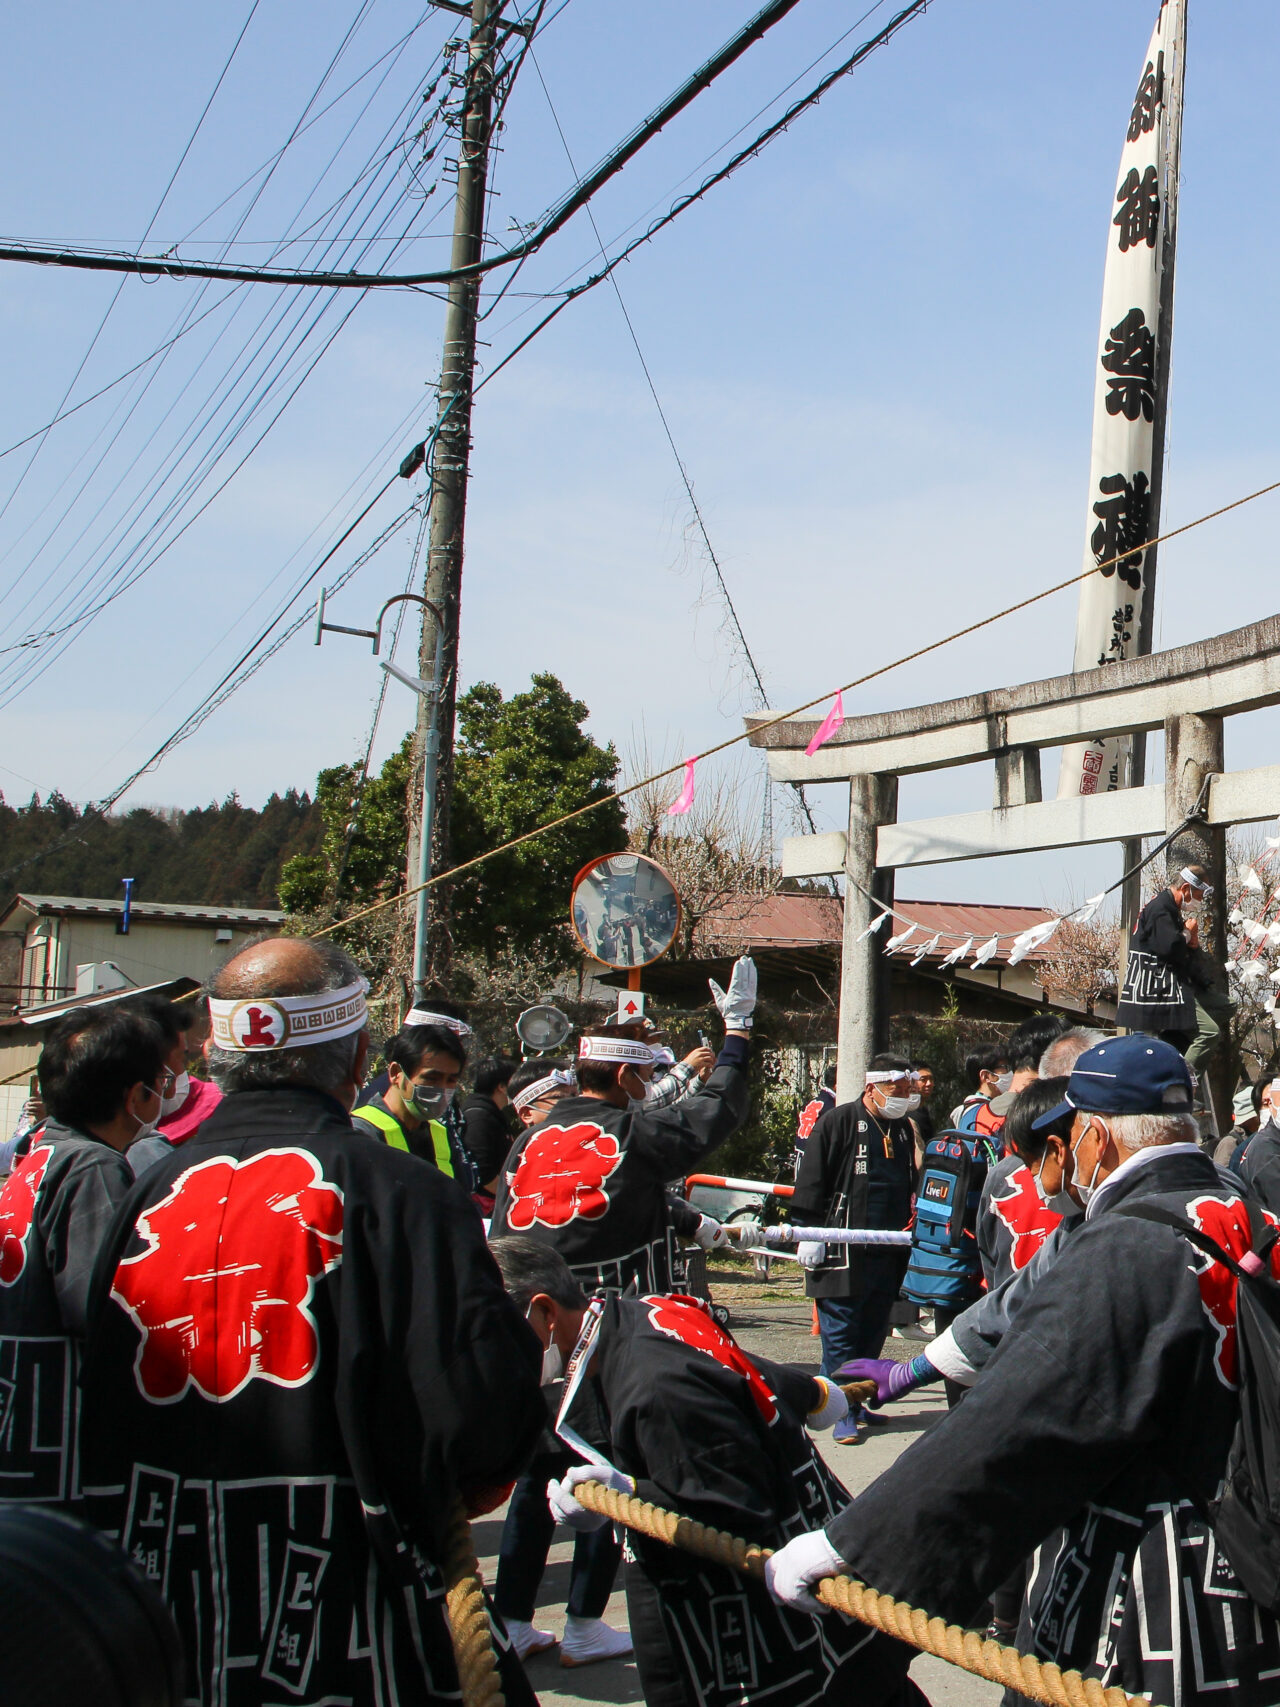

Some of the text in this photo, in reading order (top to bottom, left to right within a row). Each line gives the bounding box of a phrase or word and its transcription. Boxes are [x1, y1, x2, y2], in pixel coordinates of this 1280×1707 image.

[241, 1006, 276, 1047] 上
[854, 1144, 868, 1175] 上組
[925, 1181, 949, 1199] LiveU
[110, 1145, 345, 1404] 祭
[131, 1491, 166, 1581] 上組
[276, 1572, 314, 1668] 上組
[720, 1610, 750, 1676] 上組
